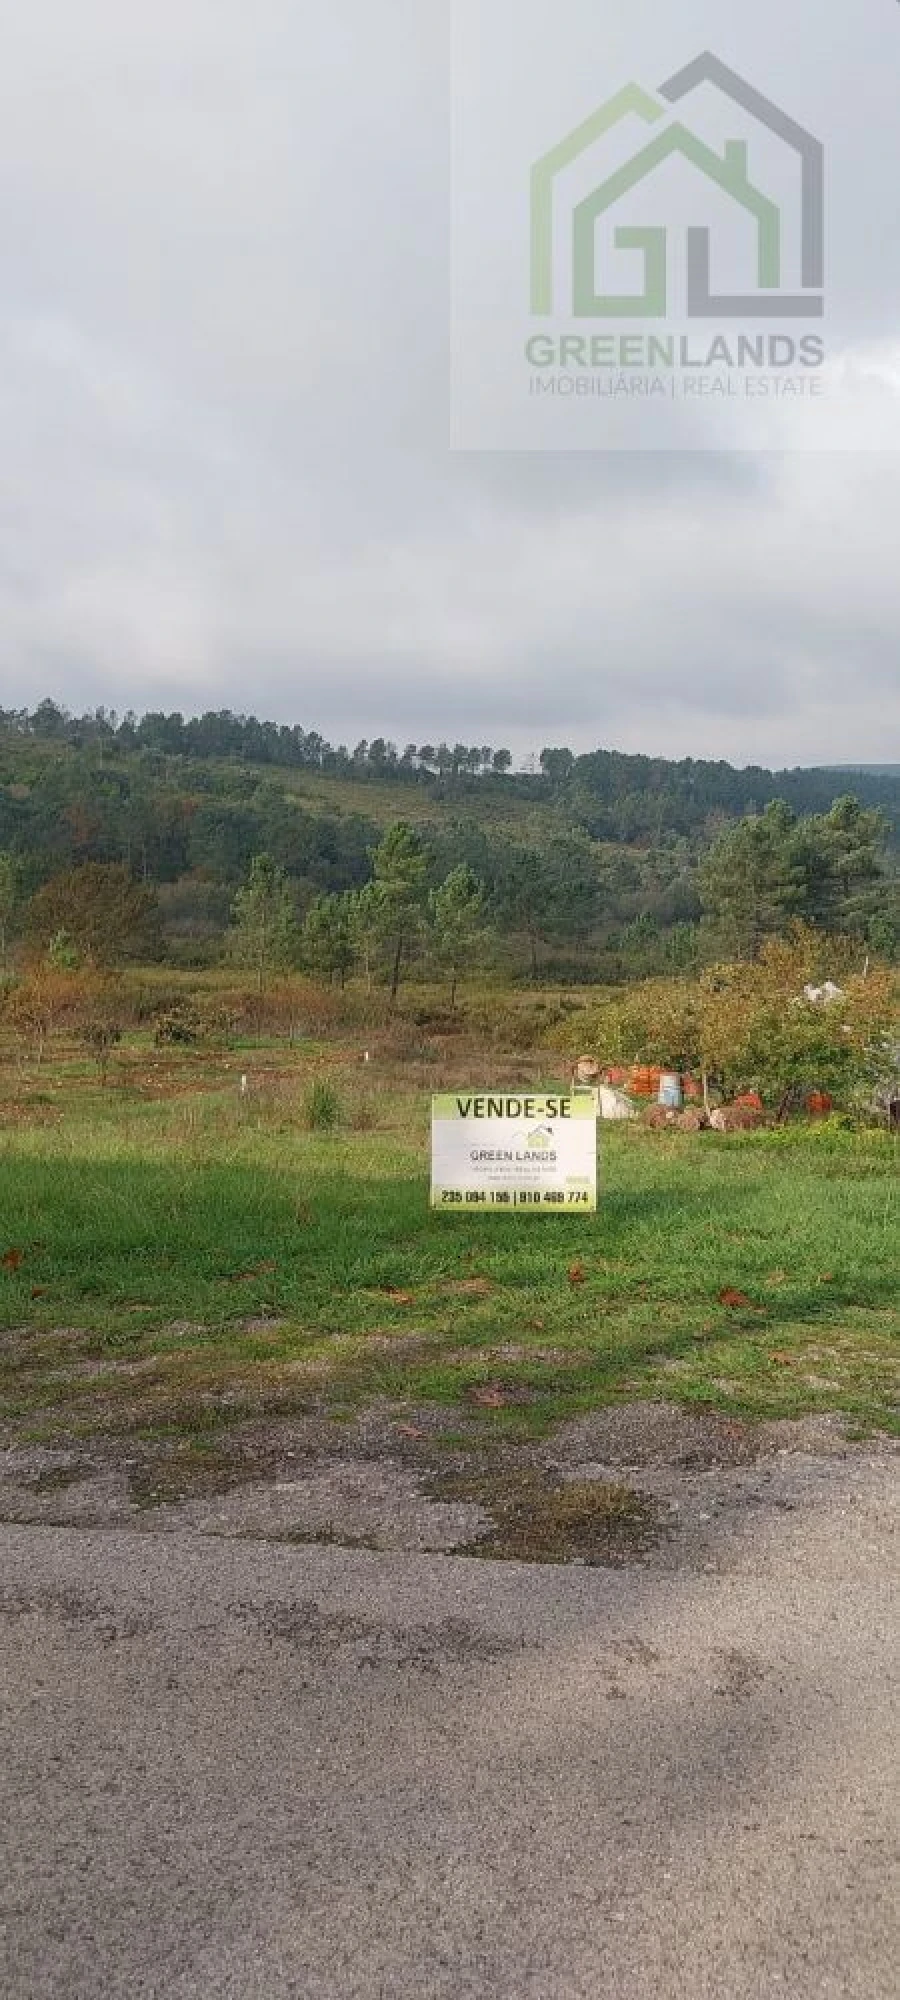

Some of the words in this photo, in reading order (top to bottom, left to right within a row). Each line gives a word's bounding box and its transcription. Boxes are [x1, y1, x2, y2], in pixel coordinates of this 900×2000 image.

[456, 1097, 572, 1119] VENDE-SE
[470, 1150, 513, 1161] GREEN
[515, 1150, 557, 1161] LANDS
[441, 1191, 463, 1203] 235
[519, 1191, 541, 1203] 910
[567, 1191, 589, 1203] 774
